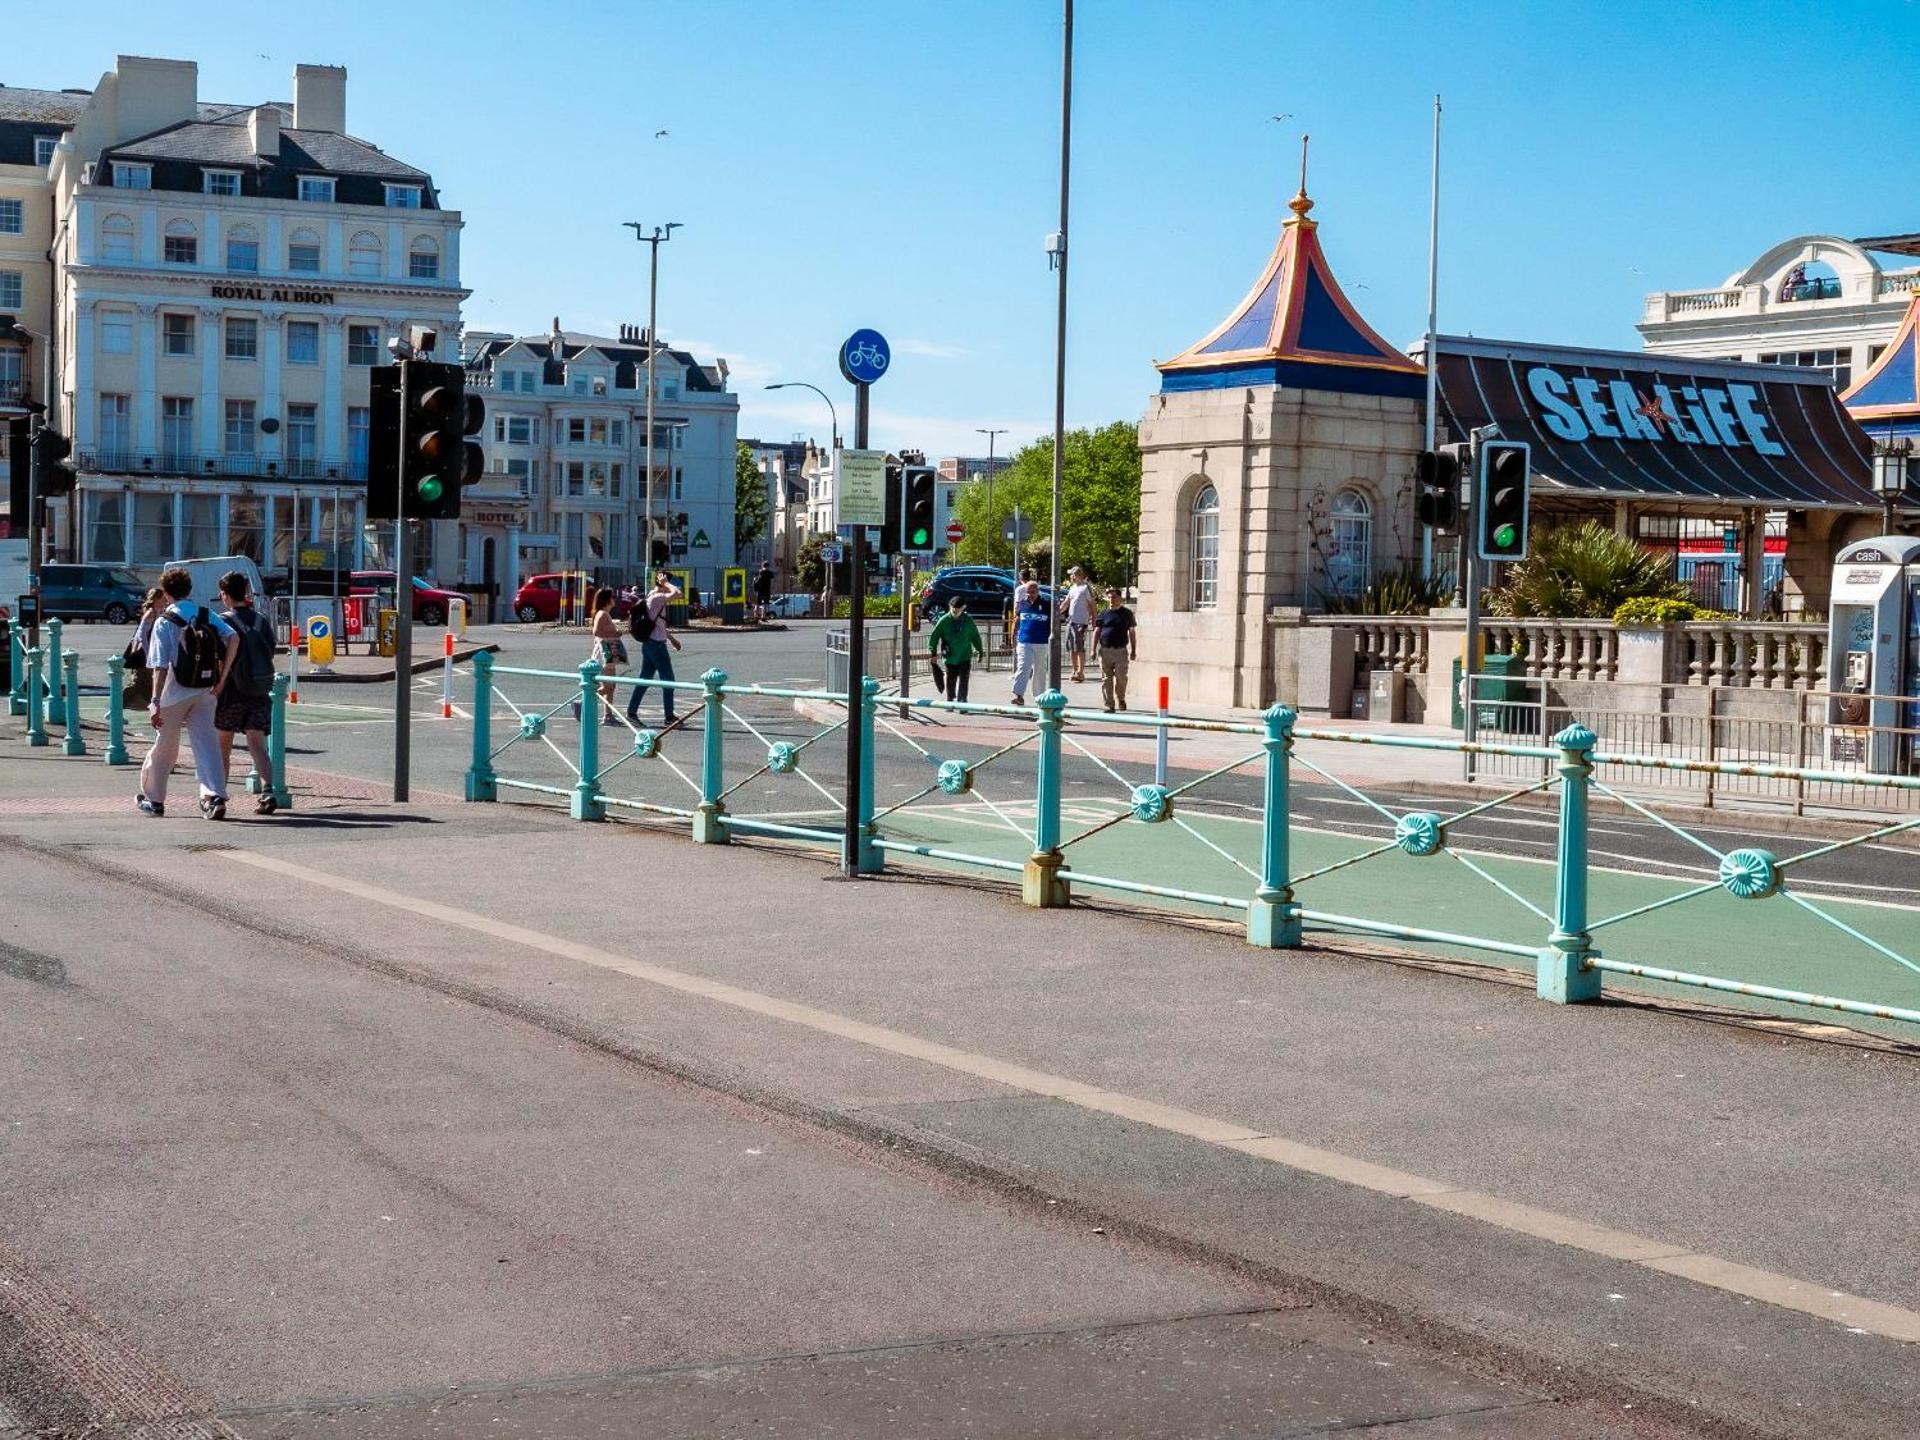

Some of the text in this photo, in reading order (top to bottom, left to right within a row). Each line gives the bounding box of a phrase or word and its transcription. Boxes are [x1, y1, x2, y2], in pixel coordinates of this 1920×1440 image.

[211, 286, 266, 301] ROYAL
[1527, 366, 1663, 443] SEA
[477, 512, 519, 523] HOTEL
[821, 550, 833, 558] 20
[1856, 550, 1881, 561] cash
